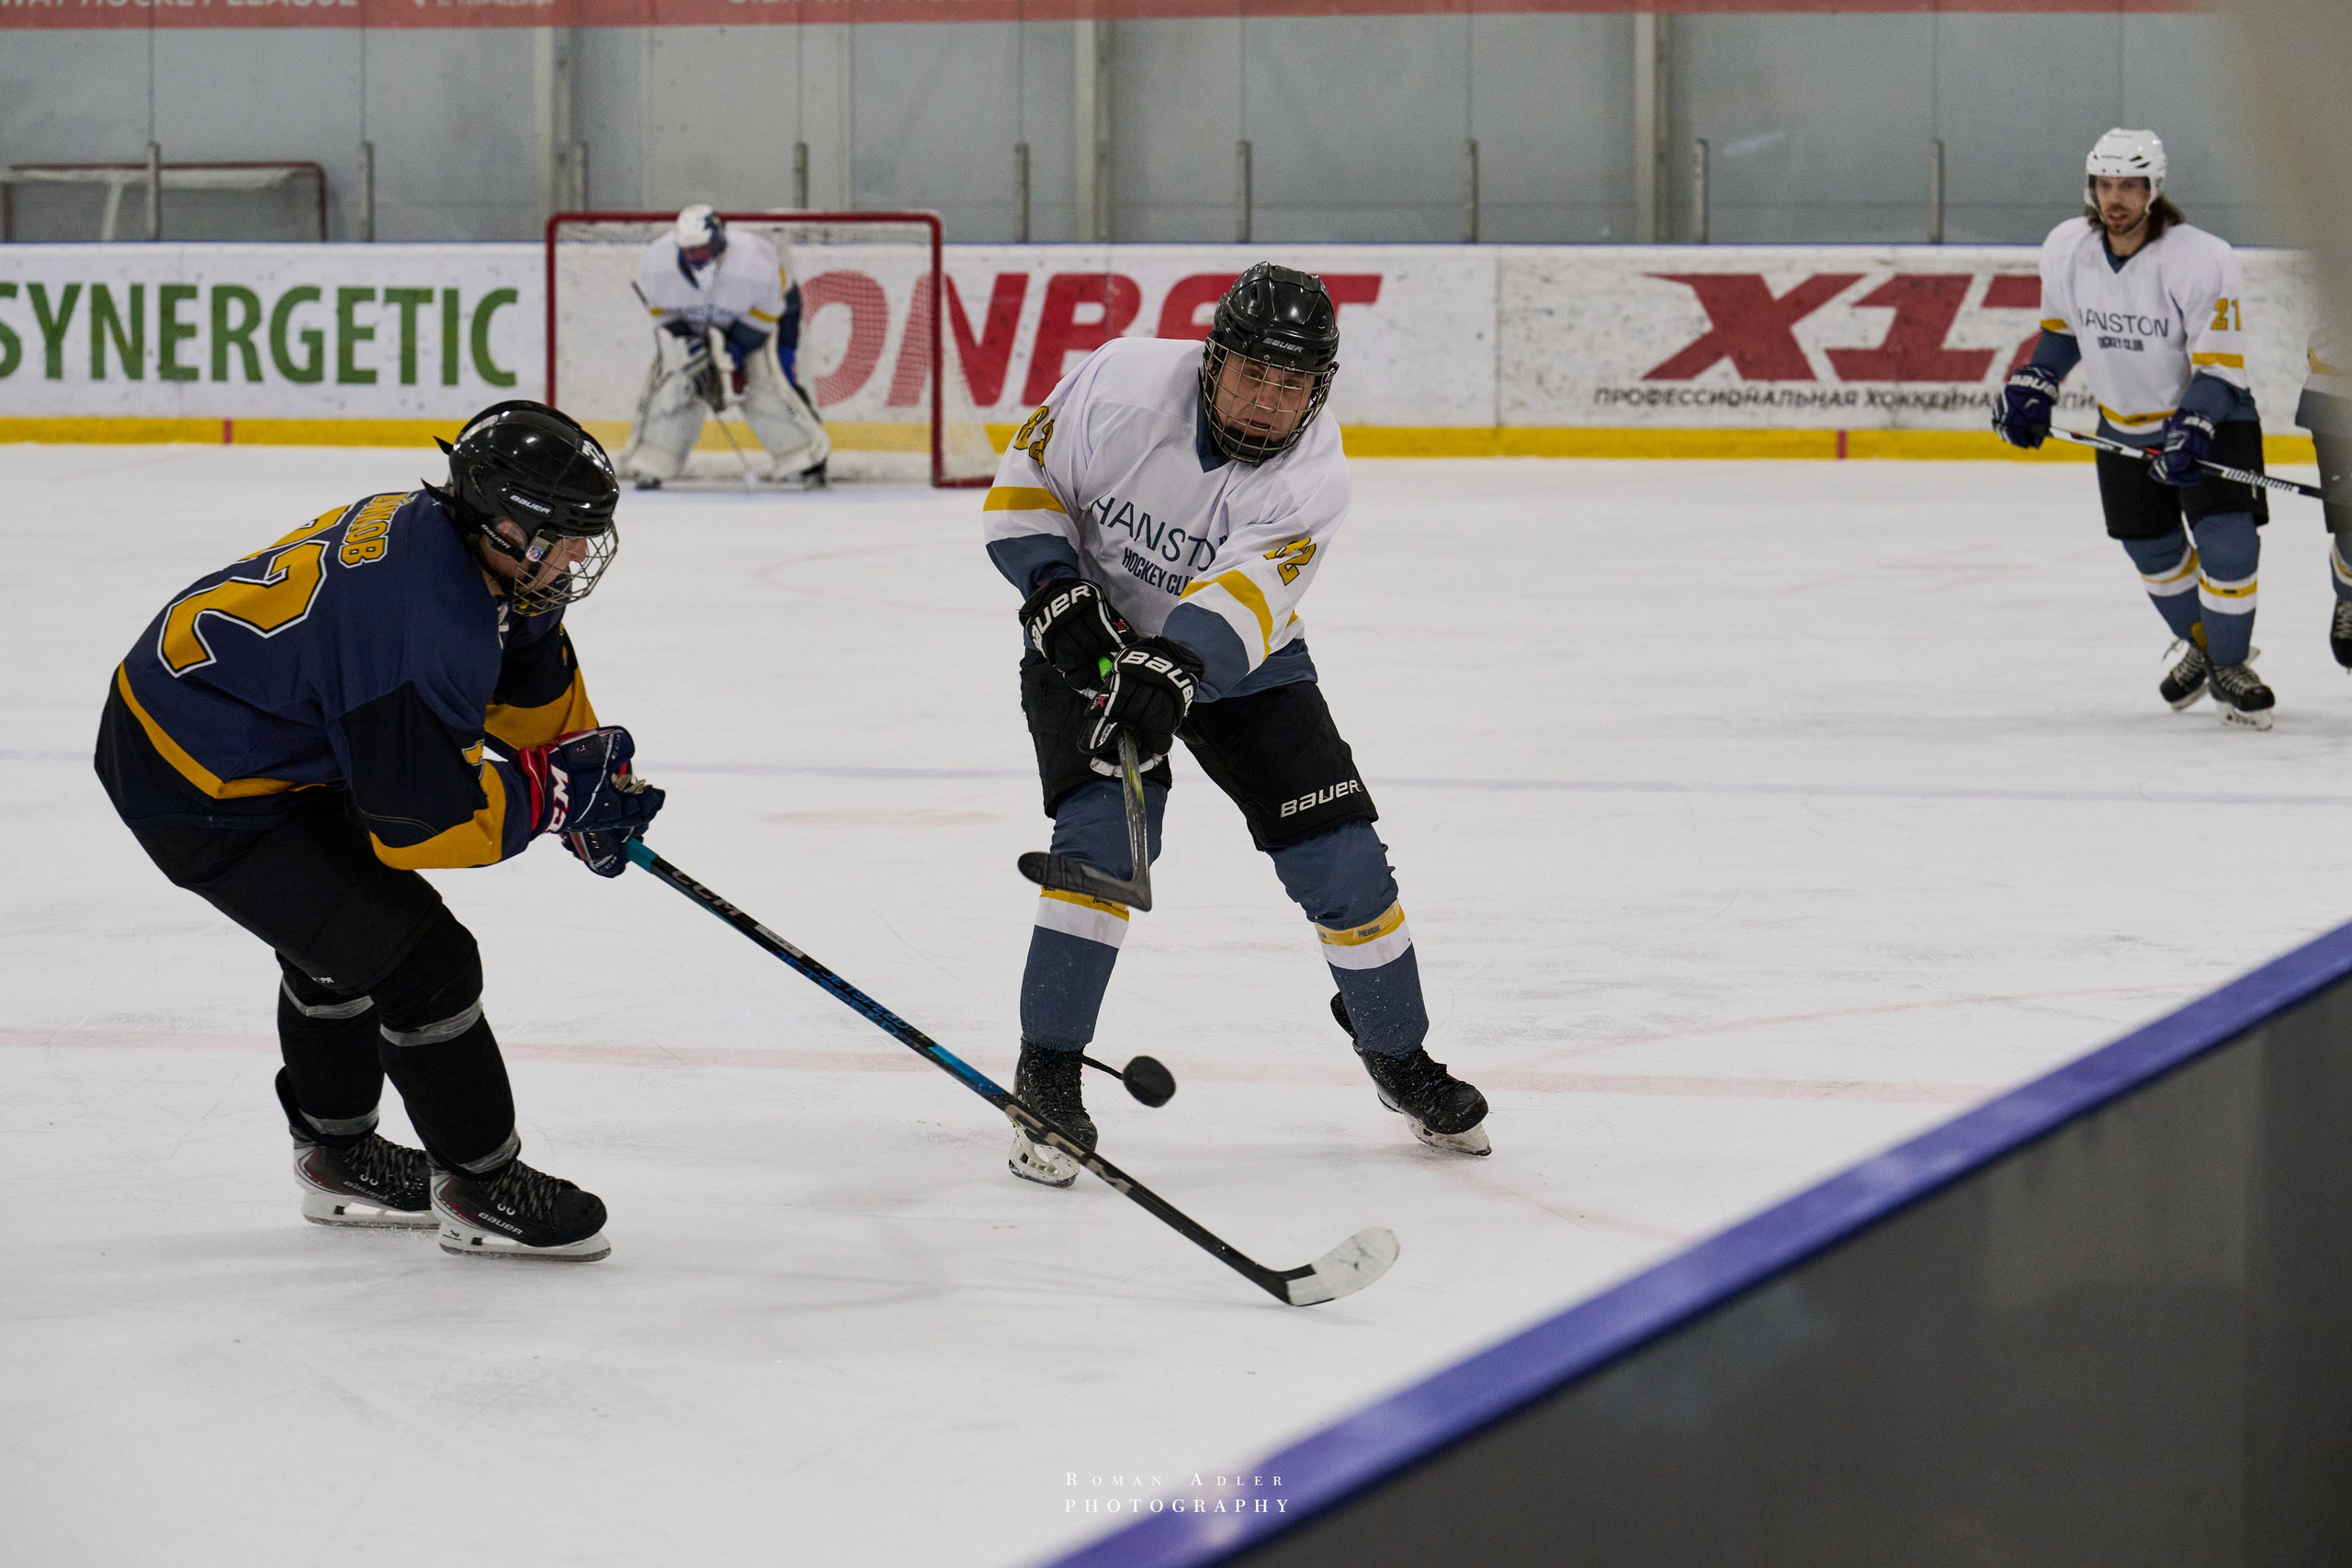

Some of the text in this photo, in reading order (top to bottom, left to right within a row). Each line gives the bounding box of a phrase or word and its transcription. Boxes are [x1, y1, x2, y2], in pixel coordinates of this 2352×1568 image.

[0, 282, 519, 388] SYNERGETIC
[2211, 298, 2243, 332] 21
[1091, 494, 1228, 572] HANSTO
[1122, 547, 1168, 589] HOCKEY
